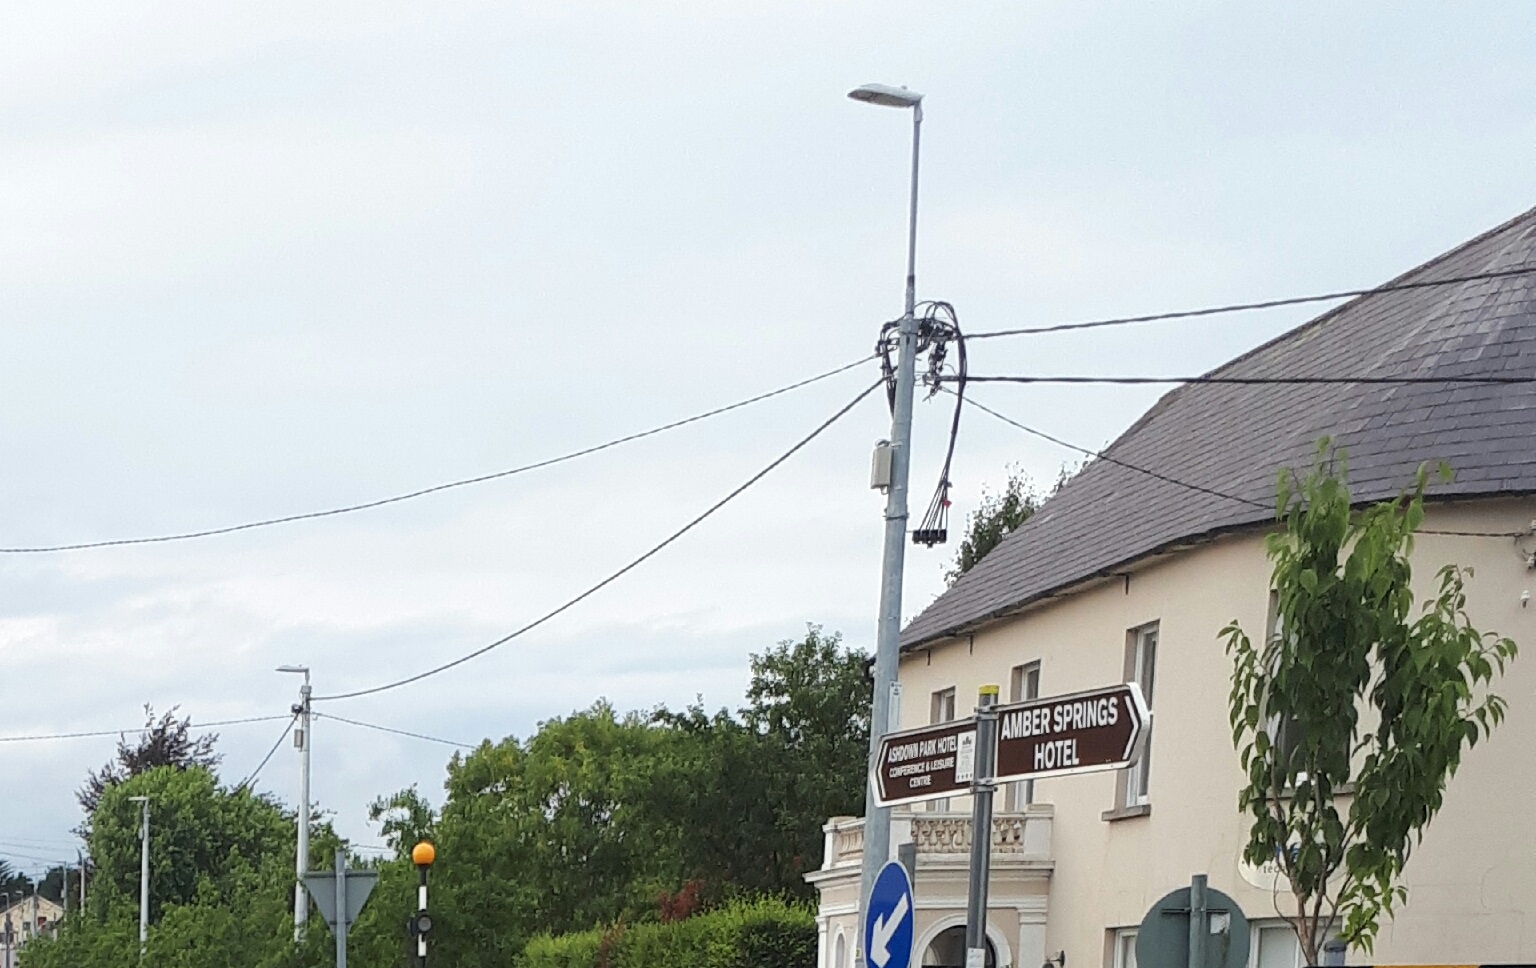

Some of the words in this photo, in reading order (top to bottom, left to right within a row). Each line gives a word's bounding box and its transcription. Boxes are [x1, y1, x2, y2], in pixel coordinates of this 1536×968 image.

[1000, 707, 1051, 740] AMBER
[1053, 696, 1119, 733] SPRINGS
[887, 743, 919, 763] ASHDOWN
[919, 739, 937, 757] PARK
[937, 735, 957, 754] HOTEL
[1034, 738, 1080, 770] HOTEL
